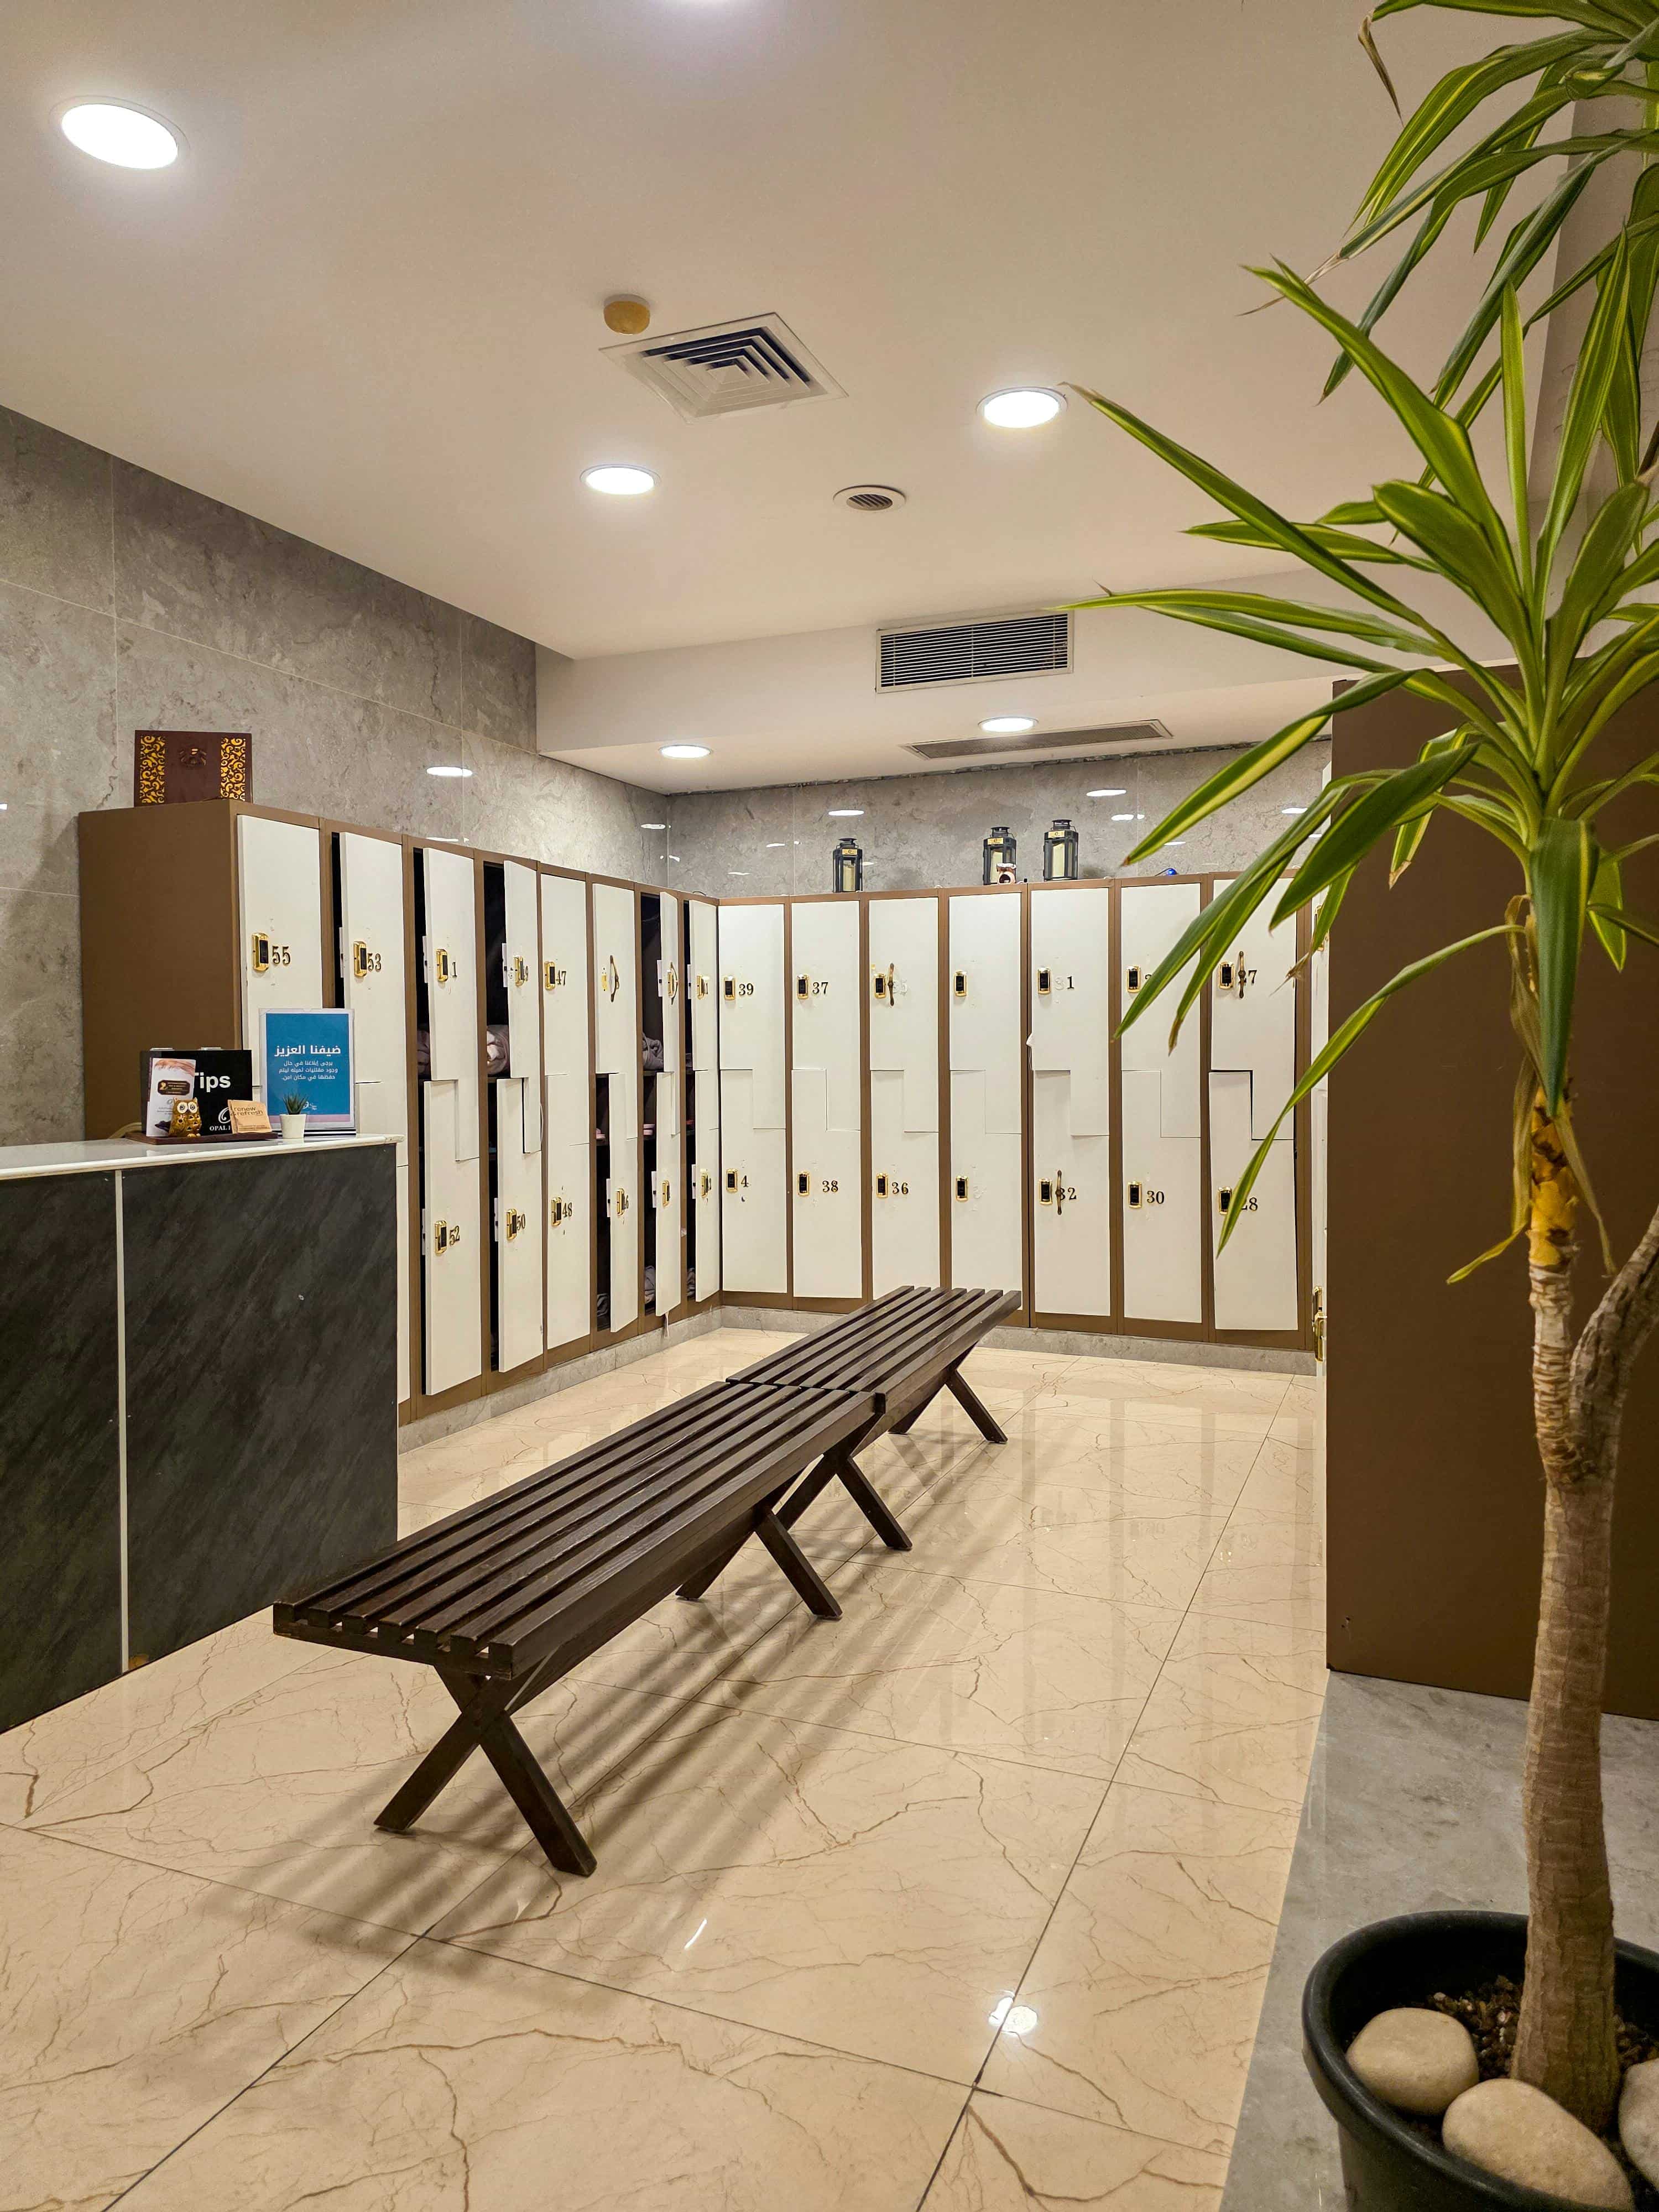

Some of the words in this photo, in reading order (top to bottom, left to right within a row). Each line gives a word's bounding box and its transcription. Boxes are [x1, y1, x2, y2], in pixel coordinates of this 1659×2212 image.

[272, 946, 290, 964] 55
[367, 953, 382, 972] 53
[452, 962, 457, 978] 1
[555, 974, 566, 985] 47
[738, 983, 754, 996] 39
[812, 982, 828, 995] 37
[274, 1045, 305, 1057] العزيز
[310, 1045, 341, 1057] ضيفنا
[740, 1175, 749, 1188] 4
[822, 1180, 838, 1193] 38
[891, 1182, 909, 1194] 36
[1146, 1190, 1165, 1204] 30
[562, 1202, 572, 1218] 48
[517, 1214, 526, 1230] 50
[450, 1225, 460, 1245] 52
